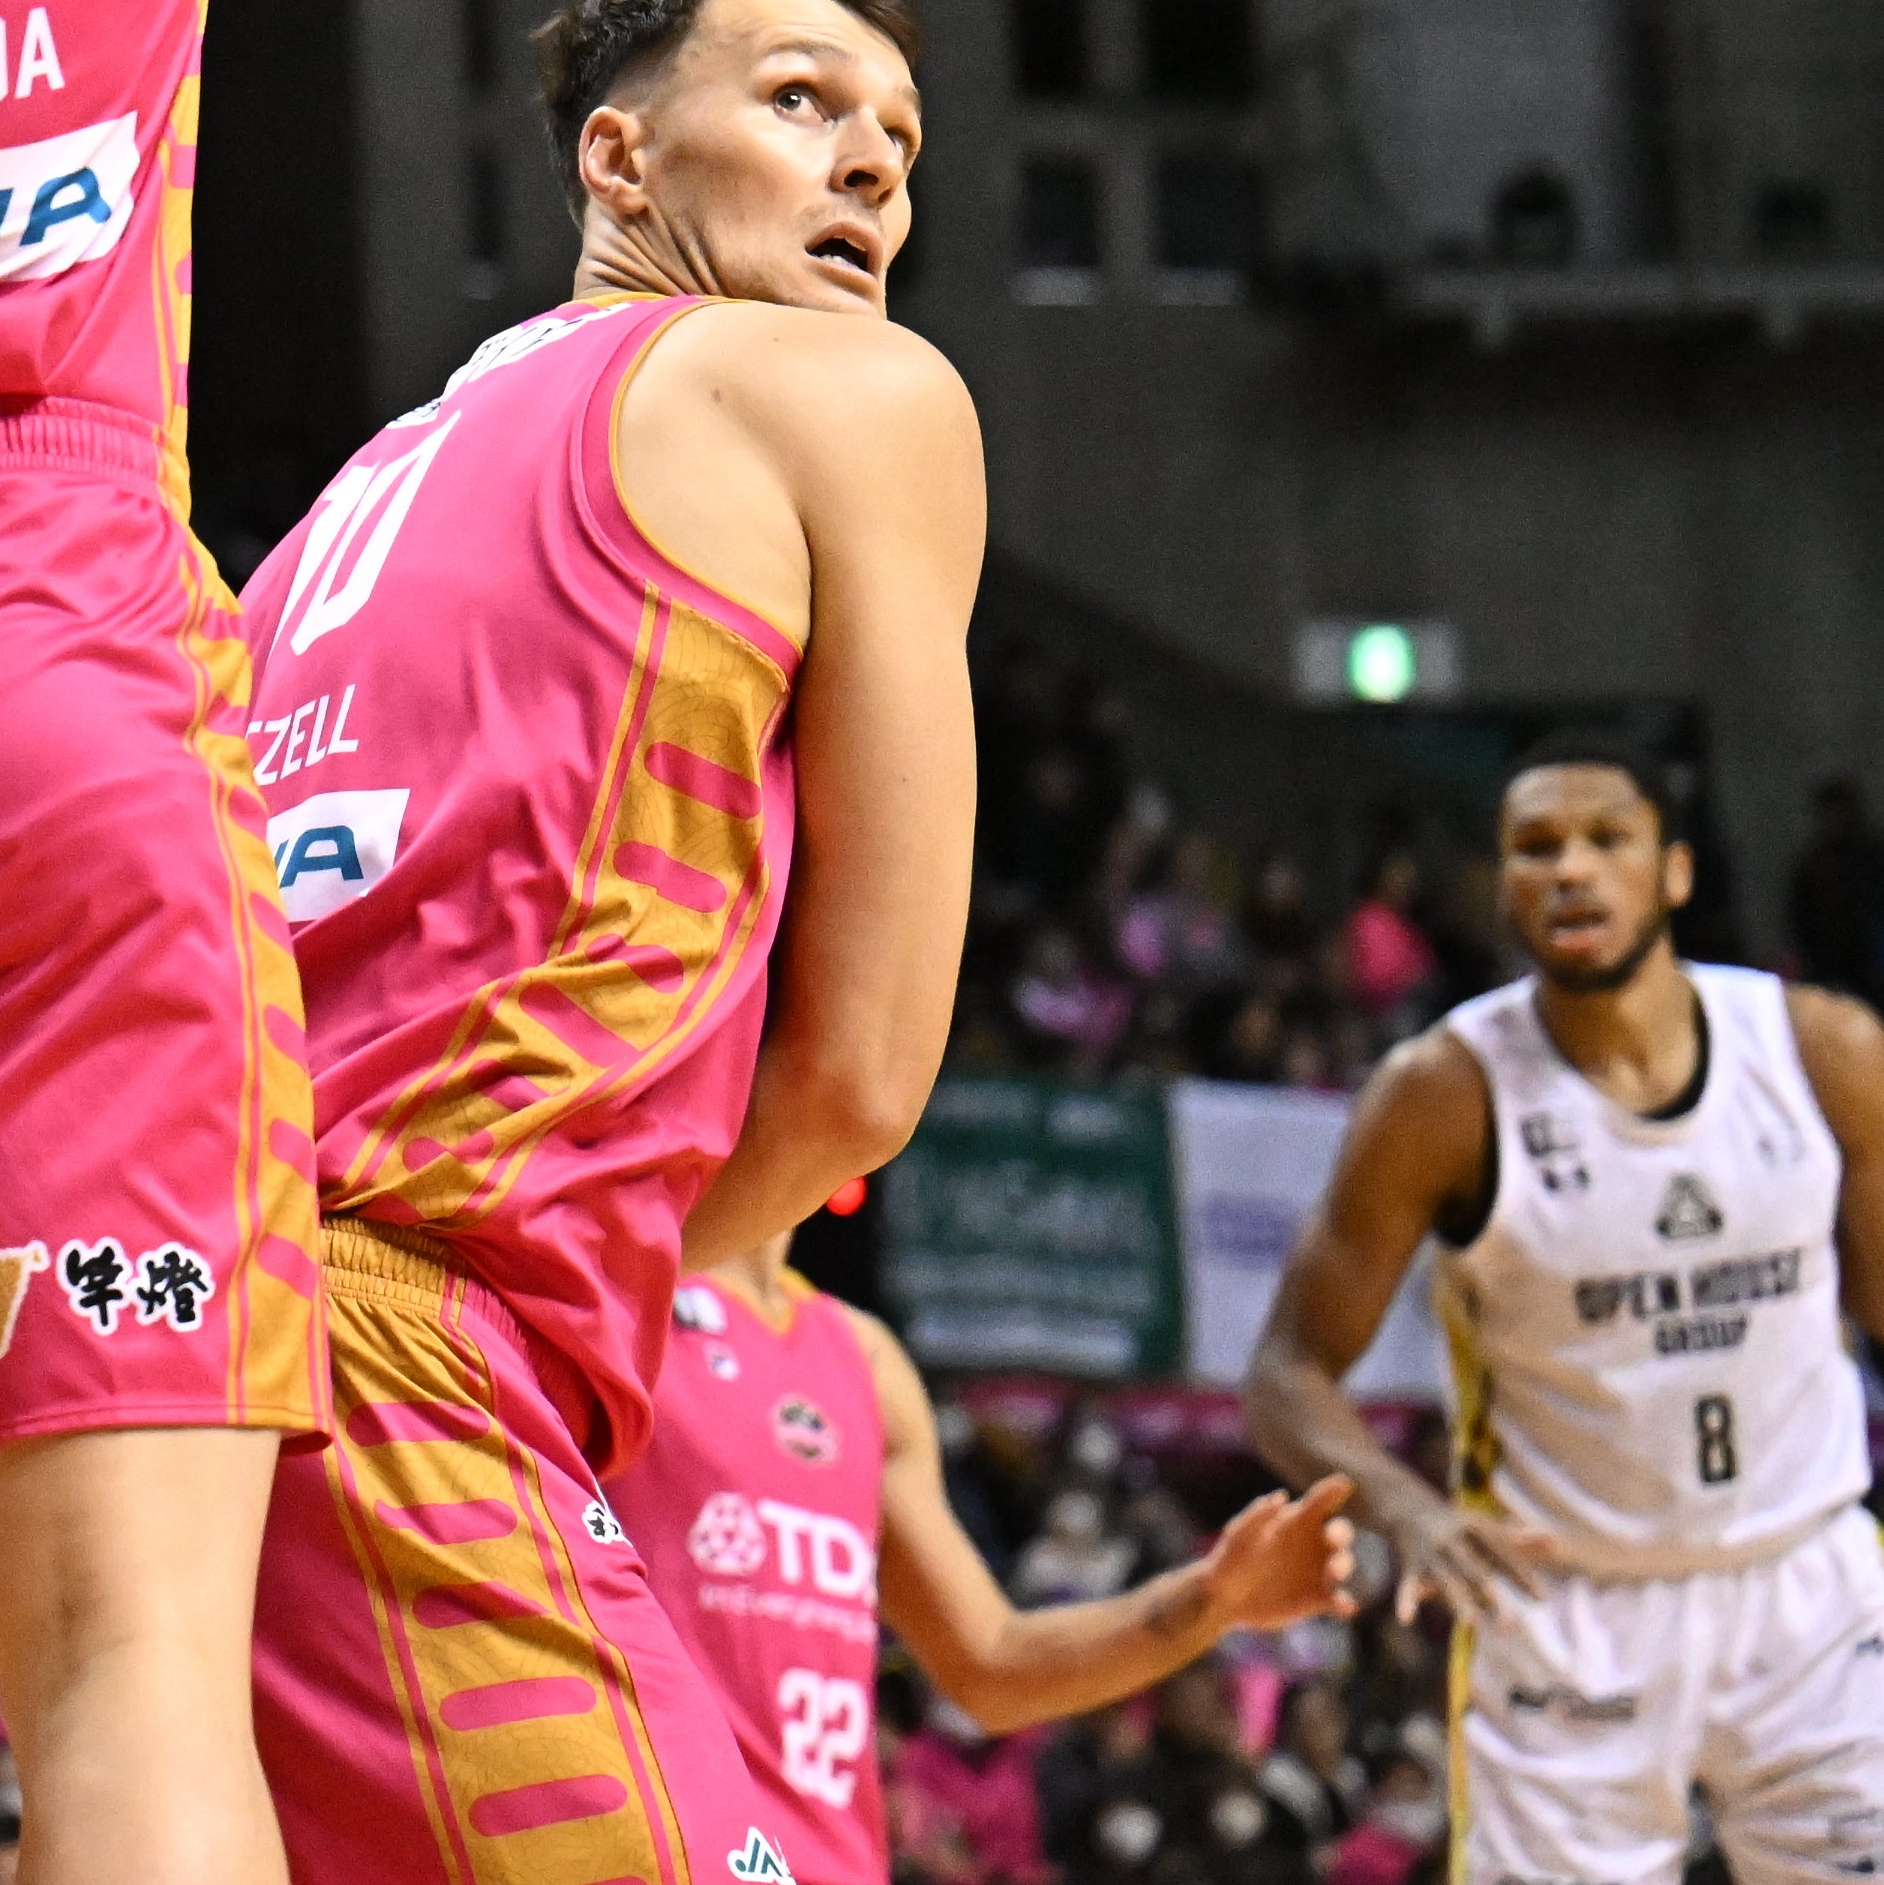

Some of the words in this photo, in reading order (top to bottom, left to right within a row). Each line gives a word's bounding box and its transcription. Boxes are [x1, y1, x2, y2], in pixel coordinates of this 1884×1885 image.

[267, 408, 462, 668] 10
[1693, 1394, 1738, 1487] 8
[757, 1498, 878, 1606] TD
[777, 1666, 870, 1809] 22
